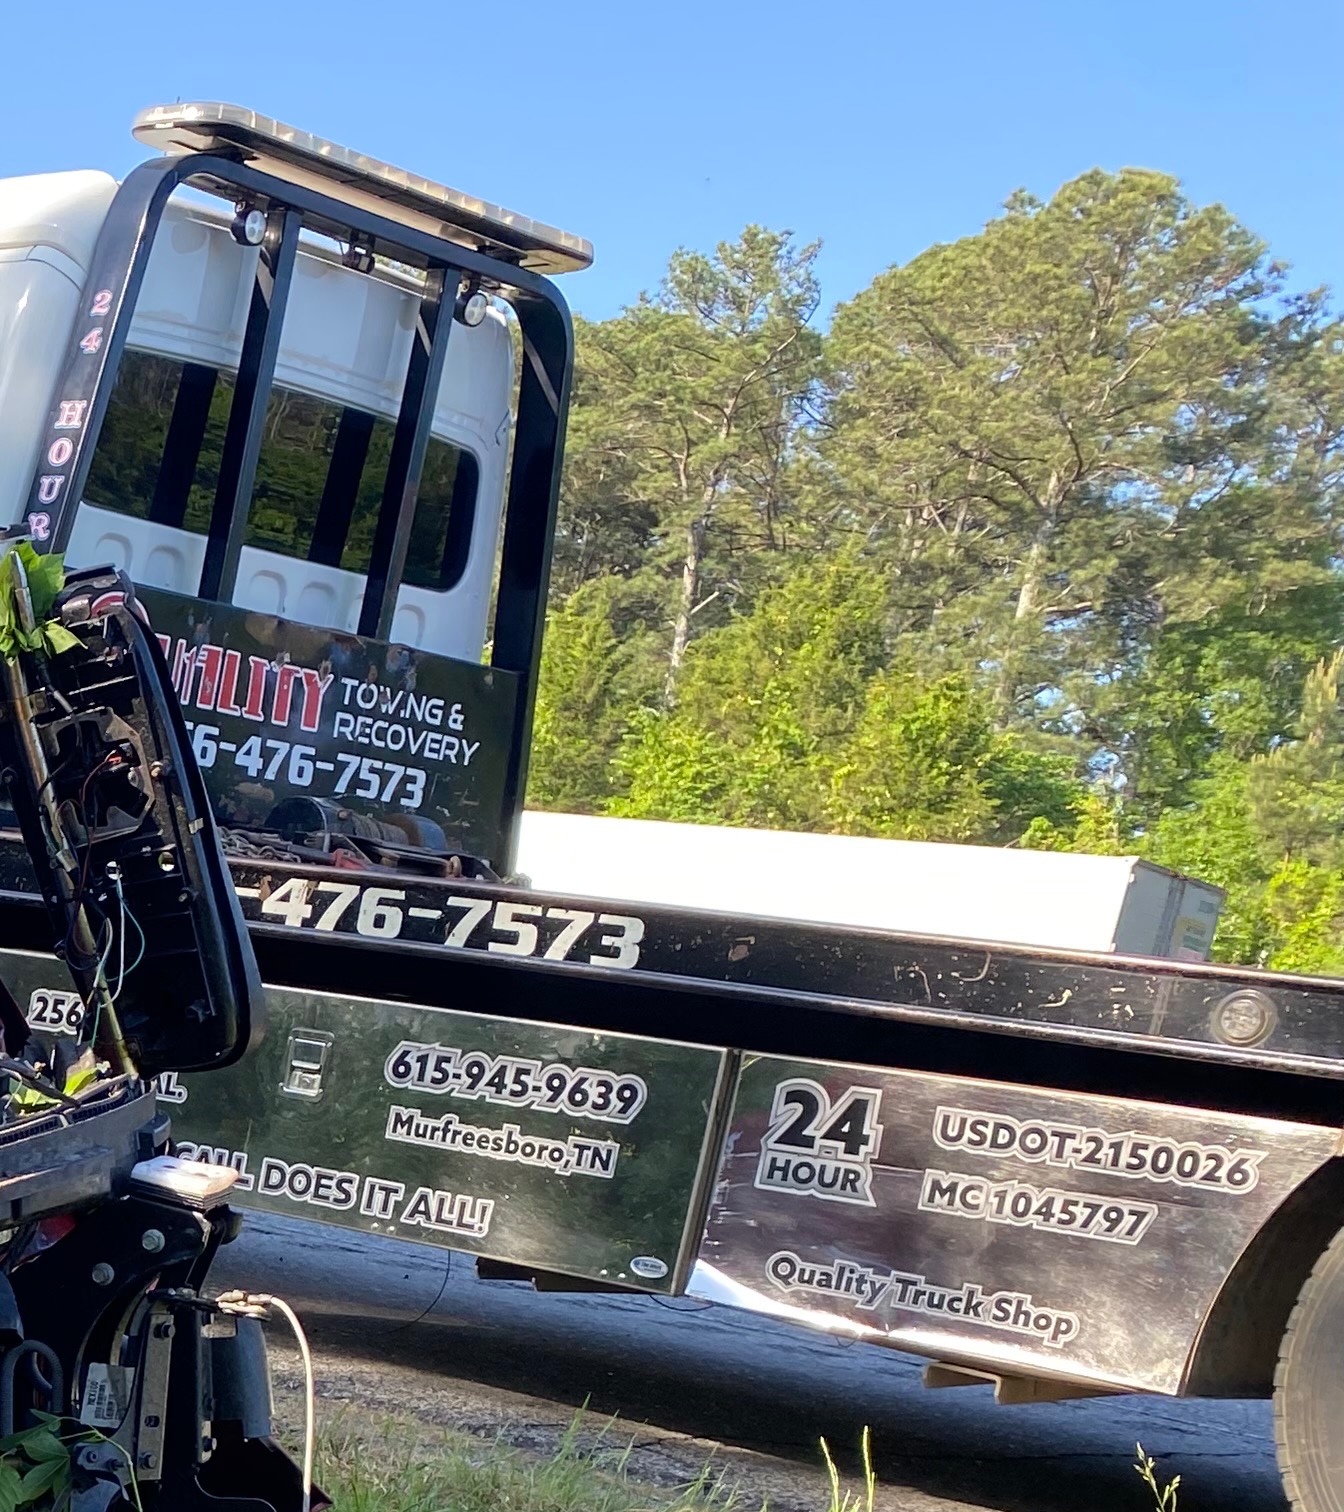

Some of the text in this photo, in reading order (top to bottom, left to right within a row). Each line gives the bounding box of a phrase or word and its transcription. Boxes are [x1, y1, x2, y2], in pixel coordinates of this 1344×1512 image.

[27, 399, 88, 541] HOUR
[340, 676, 444, 727] TOWNG
[184, 720, 427, 809] 6-476-7573
[332, 711, 481, 767] RECOVERY
[389, 1047, 642, 1117] 615-945-9639
[389, 1109, 616, 1174] Murfreesboro,TN
[766, 1087, 874, 1157] 24
[940, 1113, 1253, 1188] USDOT-2150026
[263, 1162, 354, 1207] DOES
[363, 1181, 402, 1216] IT
[404, 1191, 491, 1234] ALL!
[765, 1156, 862, 1193] HOUR
[924, 1178, 1153, 1239] MC 1045797
[769, 1254, 1077, 1343] Quality Truck Shop
